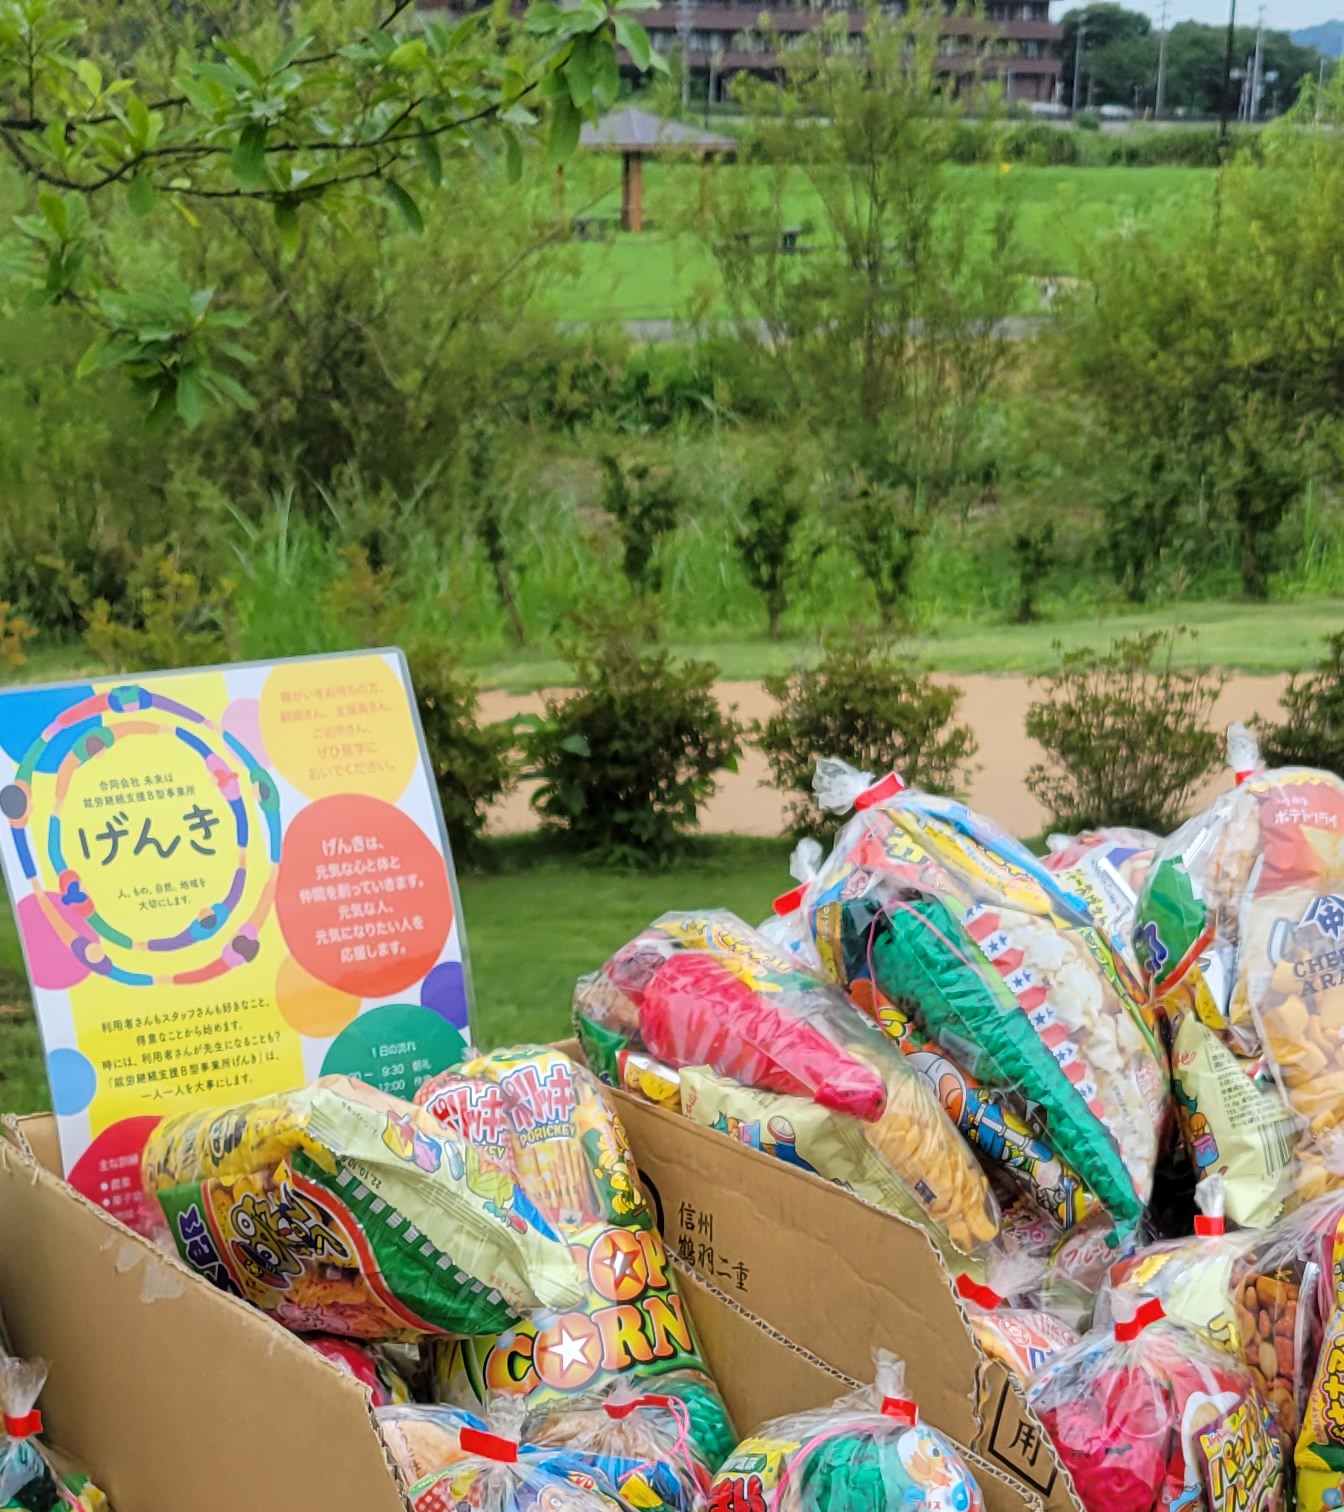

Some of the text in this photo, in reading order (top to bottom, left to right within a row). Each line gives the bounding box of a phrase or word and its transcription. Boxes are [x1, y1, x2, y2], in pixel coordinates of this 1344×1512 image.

[78, 804, 221, 866] げんき
[322, 837, 385, 856] げんきは、
[519, 1123, 578, 1148] PORICKEY
[676, 1201, 716, 1234] 信州
[483, 1296, 696, 1400] CORN
